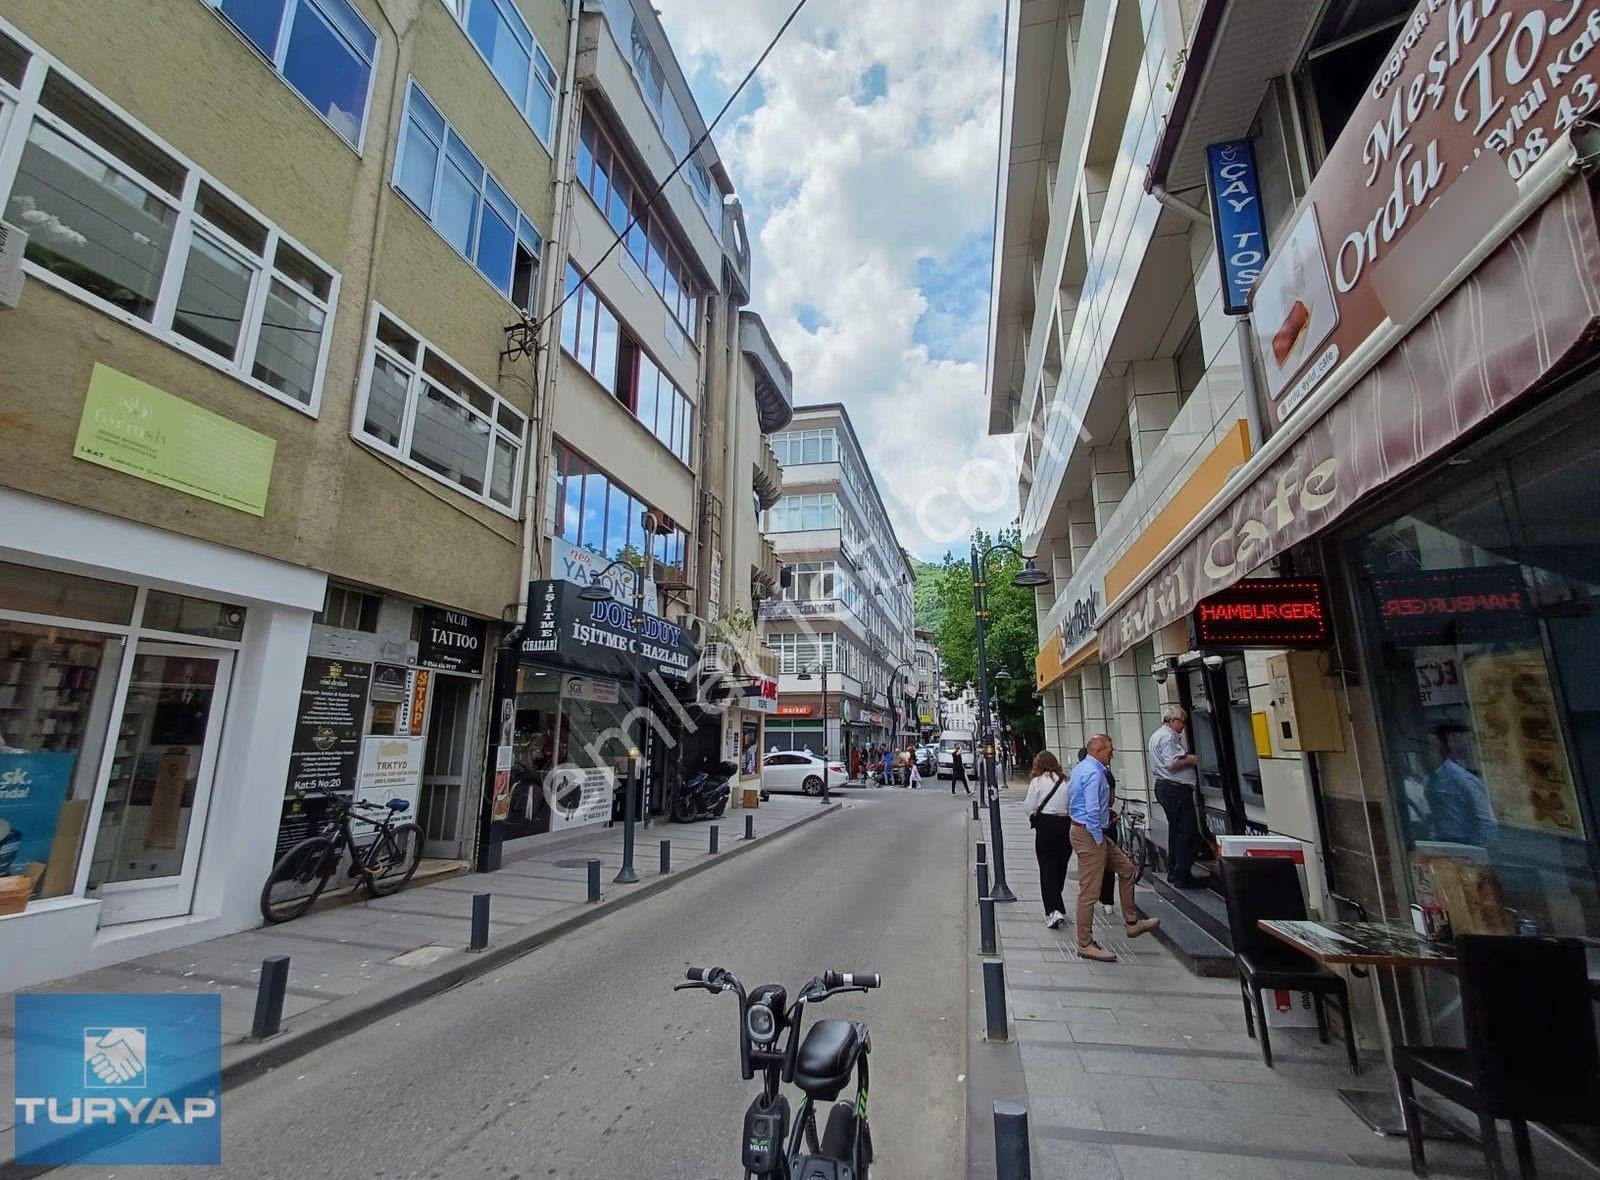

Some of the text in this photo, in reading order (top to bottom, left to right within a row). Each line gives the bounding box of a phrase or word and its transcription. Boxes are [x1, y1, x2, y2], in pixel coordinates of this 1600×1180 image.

[1362, 0, 1498, 188] Meşh
[1507, 74, 1599, 179] 08 43
[1220, 163, 1255, 213] ÇAY
[1335, 139, 1446, 292] Ordu
[1203, 455, 1338, 579] Cafe
[446, 611, 468, 627] NUR
[1201, 603, 1317, 620] HAMBURGER
[431, 627, 478, 650] TATTOO
[572, 618, 689, 668] İŞİTME CHAZLARI
[783, 706, 807, 714] market
[376, 761, 408, 770] TRKTYD
